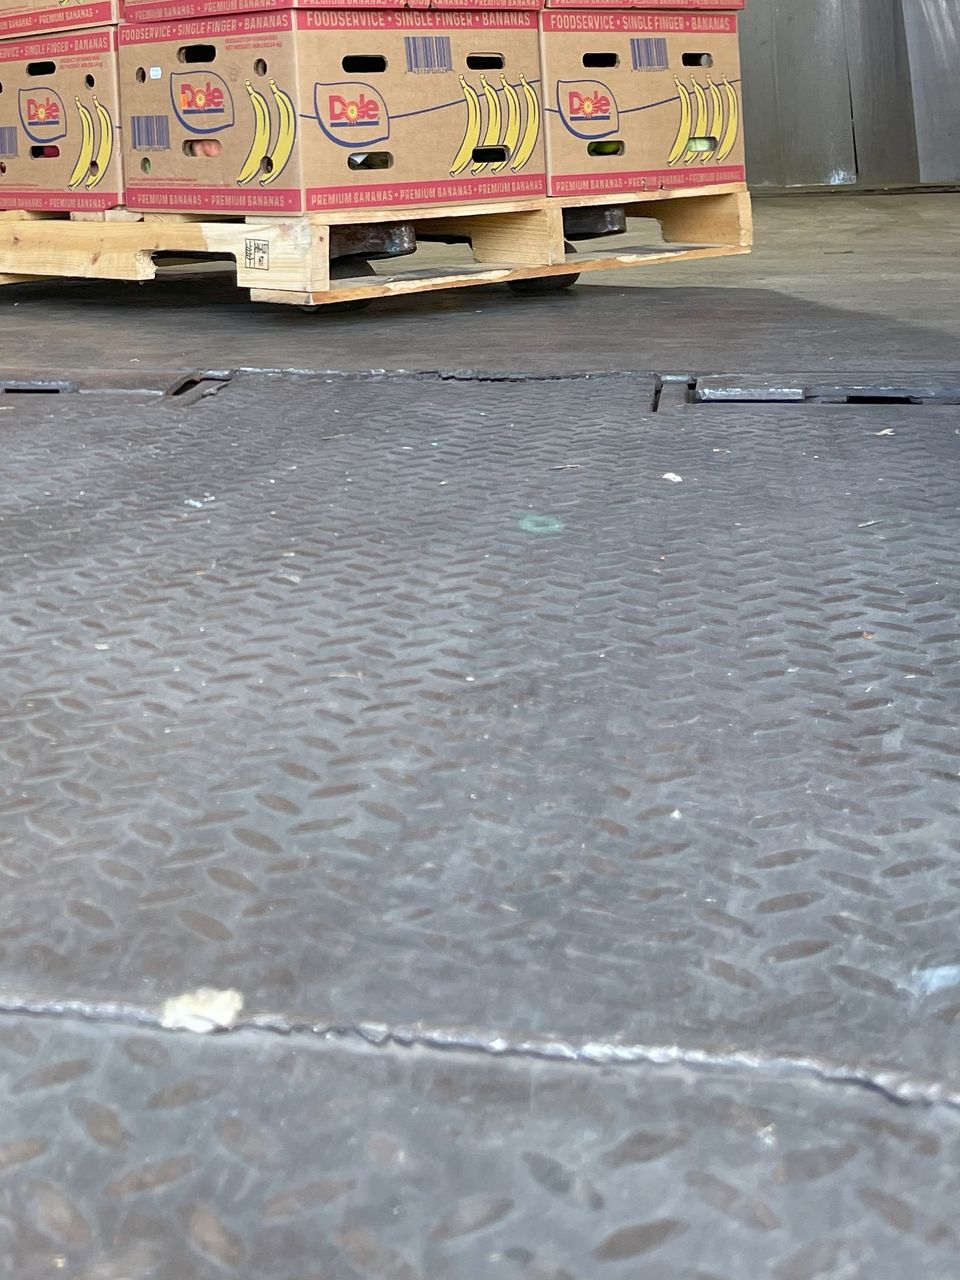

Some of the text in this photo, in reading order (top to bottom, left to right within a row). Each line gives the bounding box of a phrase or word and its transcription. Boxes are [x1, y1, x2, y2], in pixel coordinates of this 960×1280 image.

[66, 7, 94, 22] BANANAS
[135, 7, 162, 20] PREMIUM
[163, 4, 195, 17] BANANAS
[204, 0, 237, 14] PREMIUM
[307, 10, 530, 26] FOODSERVICE SINGLE FINGER BANANAS
[121, 14, 288, 42] FOODSERVICE SINGLE FINGER BANANAS
[551, 14, 730, 30] FOODSERVICE SINGLE FINGER BANANAS
[24, 36, 107, 57] SINGLE FINGER BANANAS
[181, 82, 224, 107] Dole
[569, 91, 610, 115] Dole
[27, 98, 59, 121] Dole
[329, 94, 379, 120] Dole
[312, 180, 542, 206] PREMIUM BANANAS PREMIUM BANANAS PREMIUM BANANAS
[556, 177, 623, 192] PREMIUM BANANAS
[137, 194, 285, 208] PREMIUM BANANAS PREMIUM BANANAS
